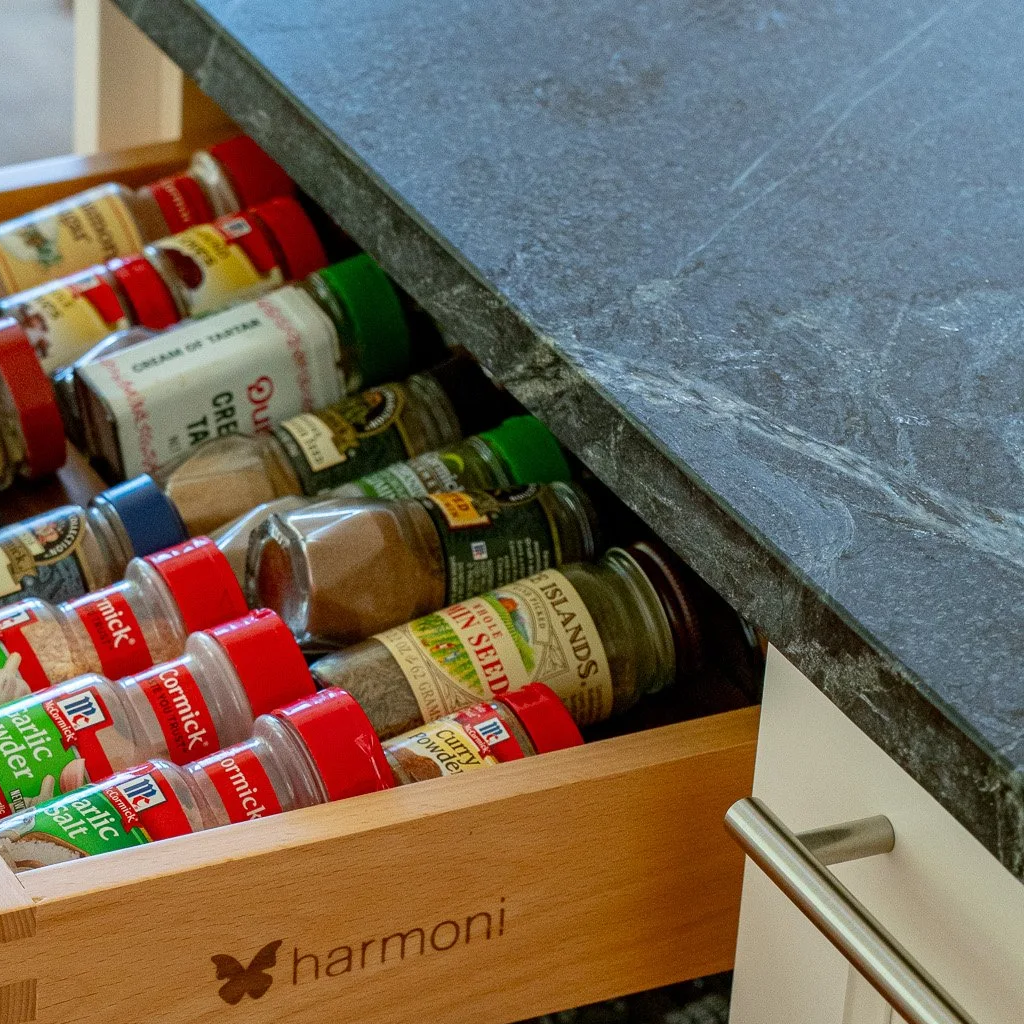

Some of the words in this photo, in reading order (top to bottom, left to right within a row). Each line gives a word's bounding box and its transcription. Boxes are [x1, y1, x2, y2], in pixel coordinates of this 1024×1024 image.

[185, 340, 203, 353] OF
[212, 391, 238, 435] CRE
[473, 603, 503, 638] WHOLE
[446, 603, 480, 631] MIN
[468, 632, 510, 695] SEED
[159, 668, 207, 750] Cormick
[436, 729, 481, 766] Curry
[105, 787, 136, 823] cCormick
[220, 757, 267, 820] ormick
[44, 804, 89, 839] Salt
[71, 798, 119, 841] arlic
[292, 897, 505, 986] harmoni
